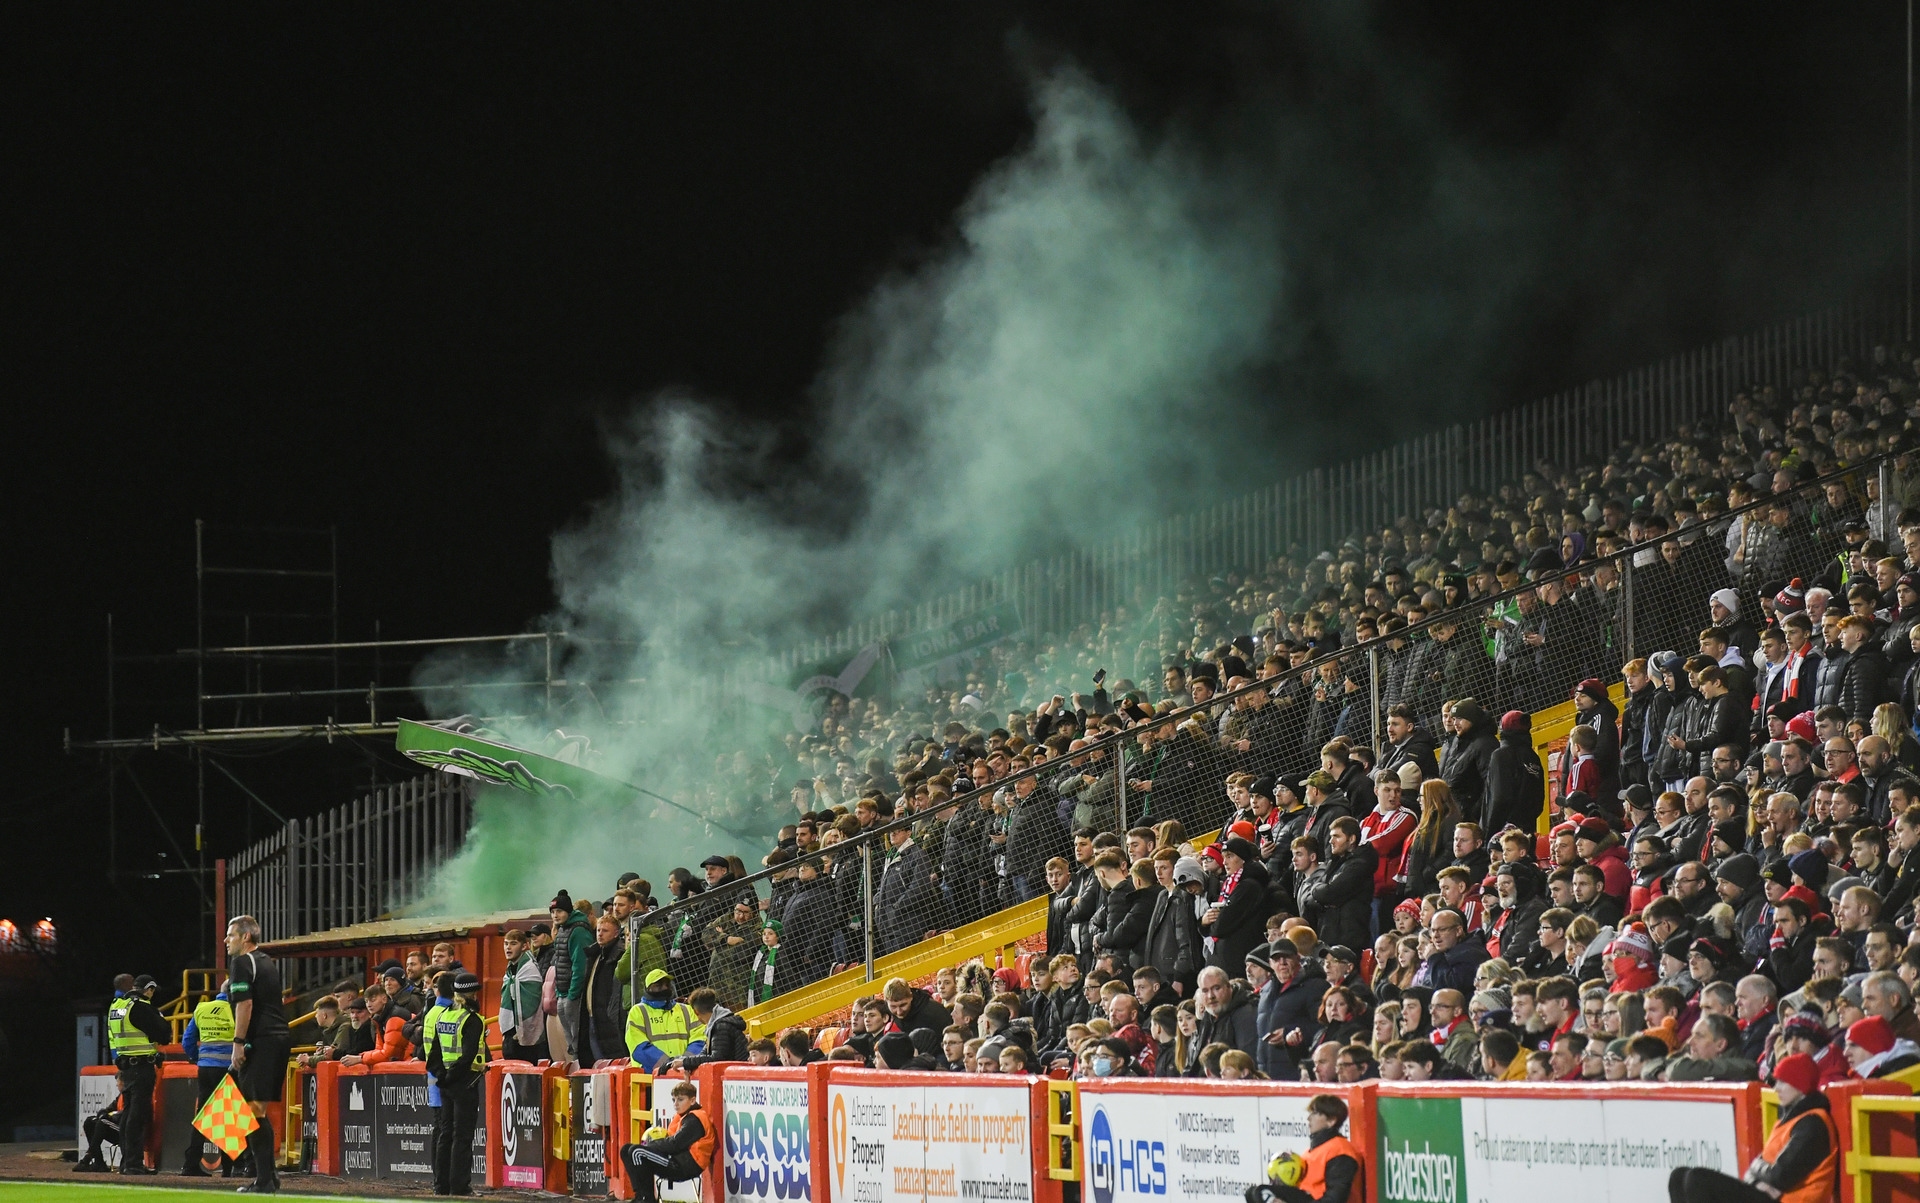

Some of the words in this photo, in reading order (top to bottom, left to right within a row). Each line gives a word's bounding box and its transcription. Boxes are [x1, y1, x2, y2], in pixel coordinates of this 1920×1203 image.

[963, 615, 999, 641] BAR
[438, 1022, 456, 1034] POLICE
[381, 1086, 396, 1106] SCOTT
[396, 1086, 412, 1112] JAMES
[751, 1086, 768, 1107] SUBSEA
[516, 1106, 540, 1126] COMPASS
[851, 1095, 887, 1127] Aberdeen
[344, 1125, 358, 1143] SCOTT
[358, 1125, 371, 1148] JAMES
[892, 1101, 930, 1153] Leading
[931, 1103, 946, 1142] the
[948, 1103, 970, 1143] field
[971, 1103, 981, 1143] in
[983, 1109, 1026, 1155] property
[1178, 1112, 1199, 1133] IWOCS
[1200, 1113, 1235, 1138] Equipment
[574, 1139, 605, 1163] RECREATE
[851, 1135, 885, 1173] Property
[1180, 1144, 1213, 1168] Manpower
[1213, 1144, 1240, 1166] Services
[1473, 1131, 1499, 1161] Proud
[1501, 1134, 1532, 1169] catering
[1533, 1135, 1548, 1164] and
[1550, 1138, 1577, 1165] events
[1578, 1138, 1609, 1172] partner
[1611, 1138, 1618, 1166] at
[1620, 1137, 1661, 1169] Aberdeen
[1662, 1138, 1698, 1169] Football
[1700, 1140, 1722, 1173] Club
[575, 1166, 585, 1189] signs
[590, 1166, 606, 1190] graphics
[1119, 1138, 1167, 1196] HCS
[1384, 1136, 1457, 1203] baxterstorey
[853, 1173, 883, 1203] Leasing
[893, 1163, 959, 1203] management.
[961, 1173, 1029, 1203] www.primelet.com
[1182, 1174, 1216, 1200] Equipment
